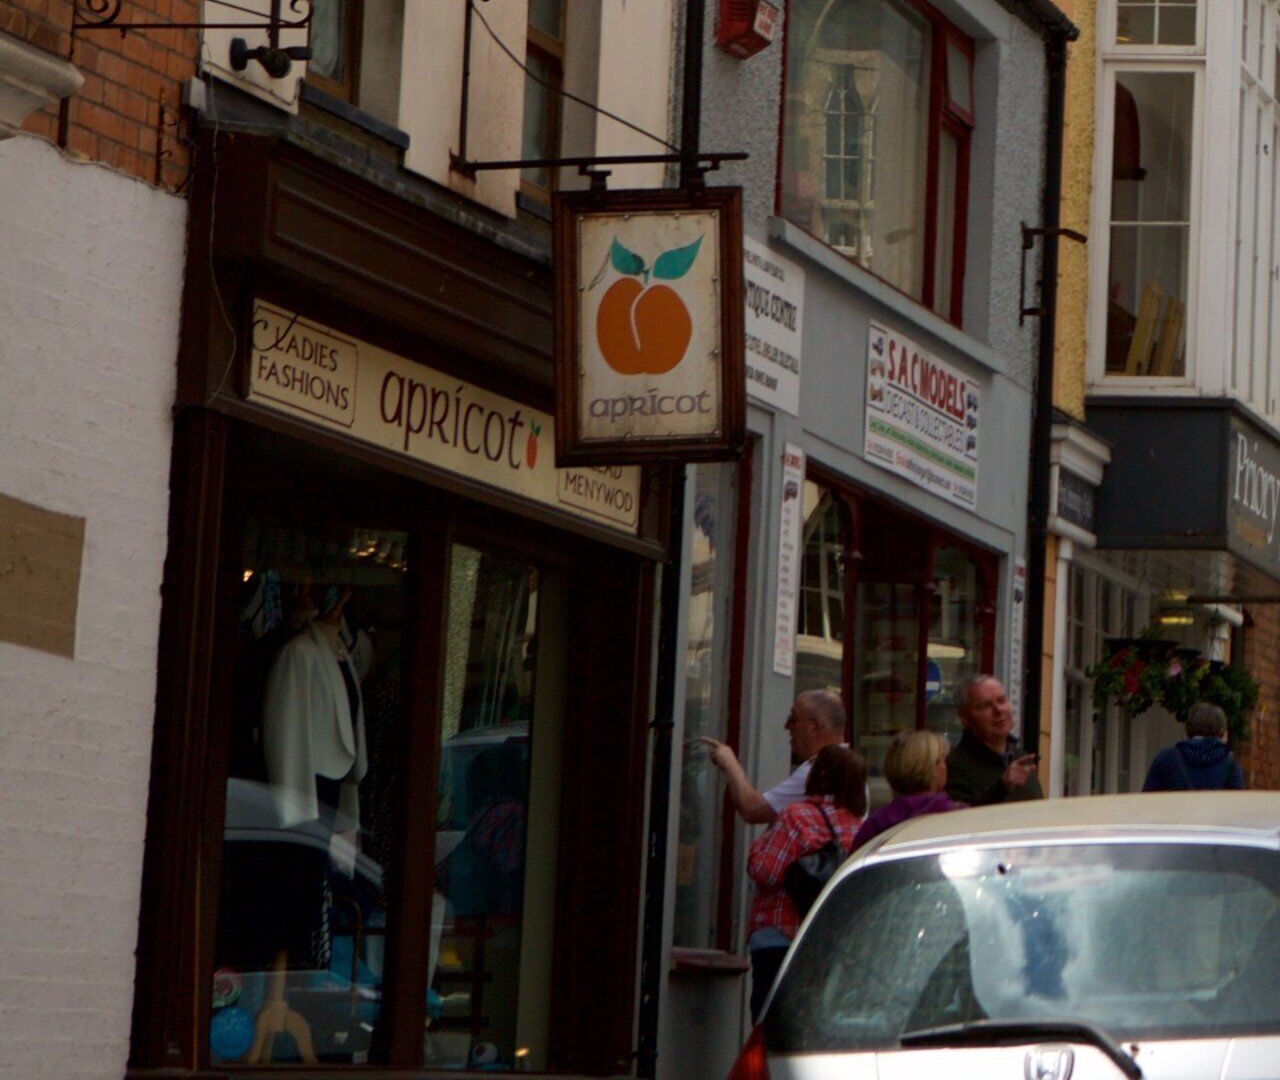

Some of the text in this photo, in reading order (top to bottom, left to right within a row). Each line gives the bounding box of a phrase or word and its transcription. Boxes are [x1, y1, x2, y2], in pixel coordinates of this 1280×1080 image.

[273, 327, 339, 372] LADIES
[257, 355, 350, 410] FASHIONS
[590, 387, 711, 424] apricot
[919, 357, 967, 421] MODELS
[380, 370, 525, 470] apricot
[564, 472, 633, 513] MENYWOD
